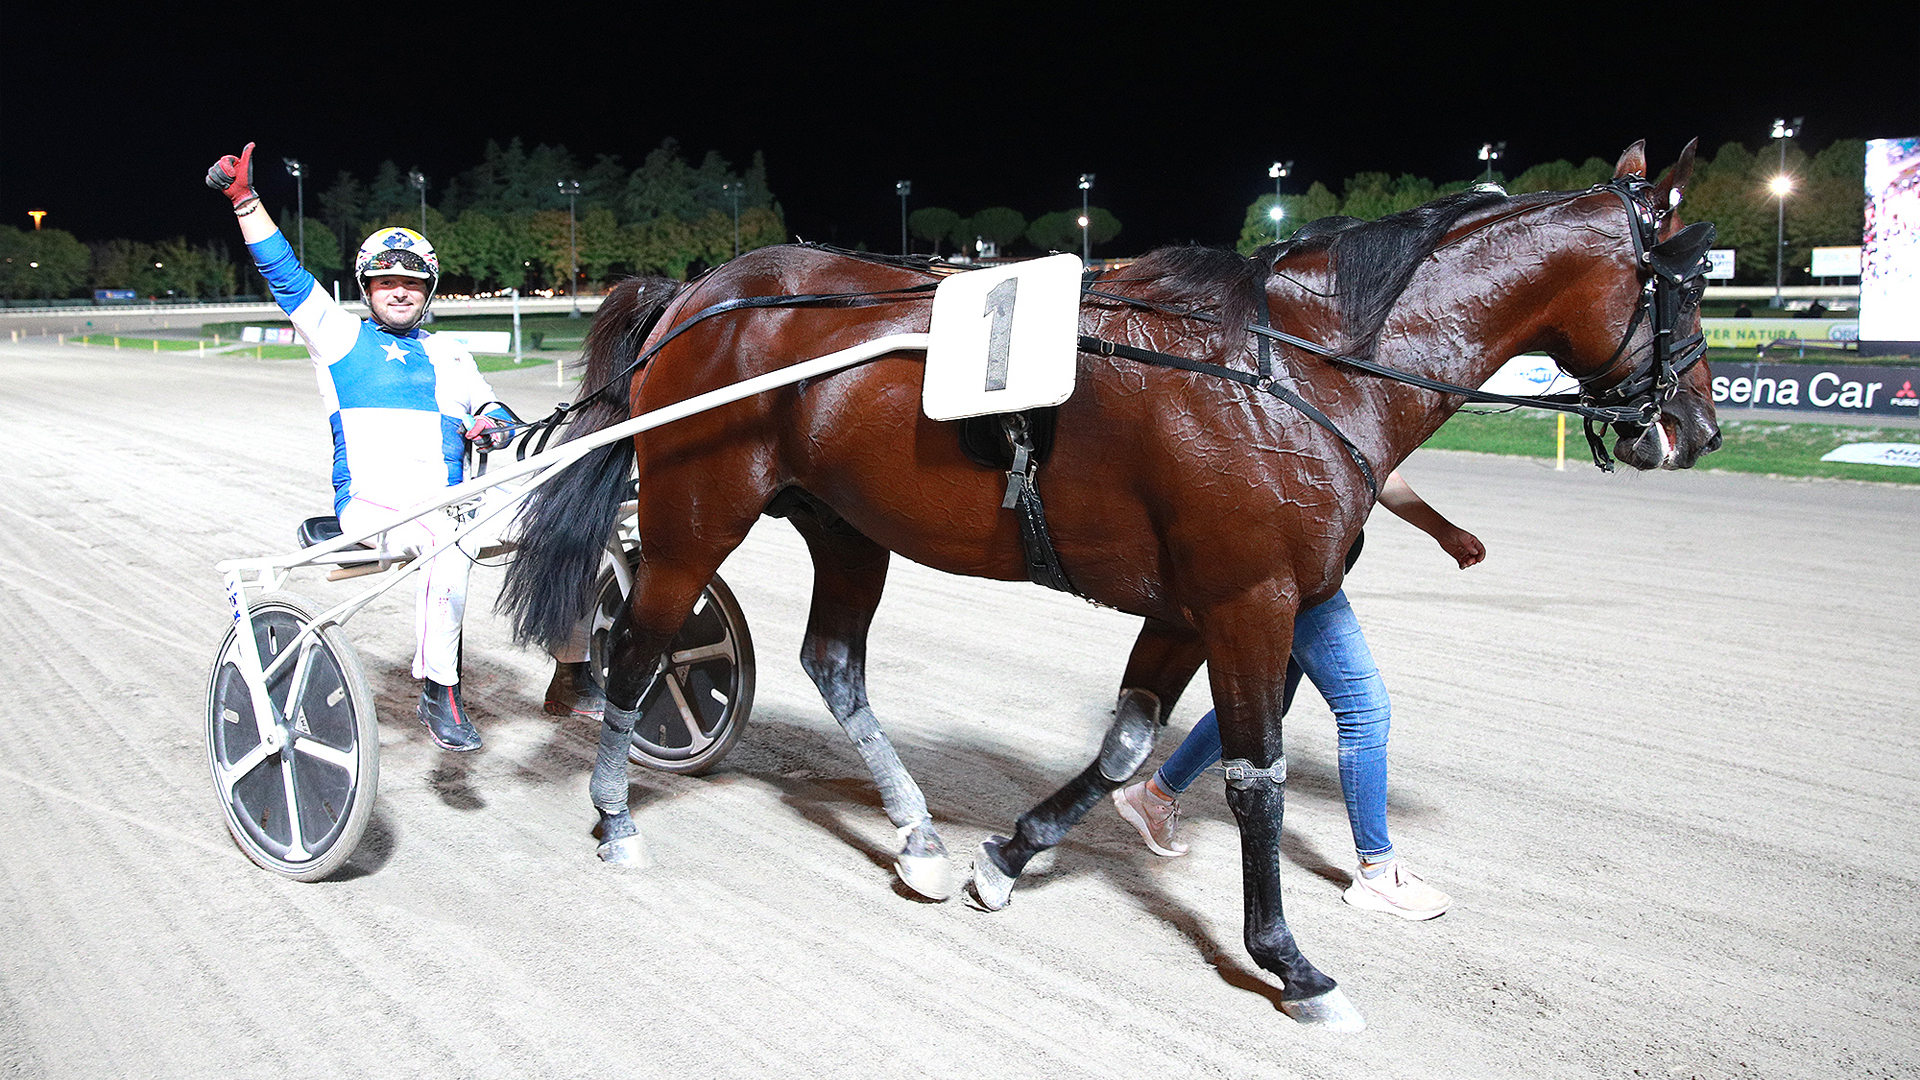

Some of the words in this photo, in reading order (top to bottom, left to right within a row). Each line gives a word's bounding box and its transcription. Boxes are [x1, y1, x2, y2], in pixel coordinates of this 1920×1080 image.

[983, 276, 1018, 392] 1
[1736, 329, 1798, 340] NATURA
[1711, 376, 1800, 406] sena
[1808, 371, 1883, 409] Car
